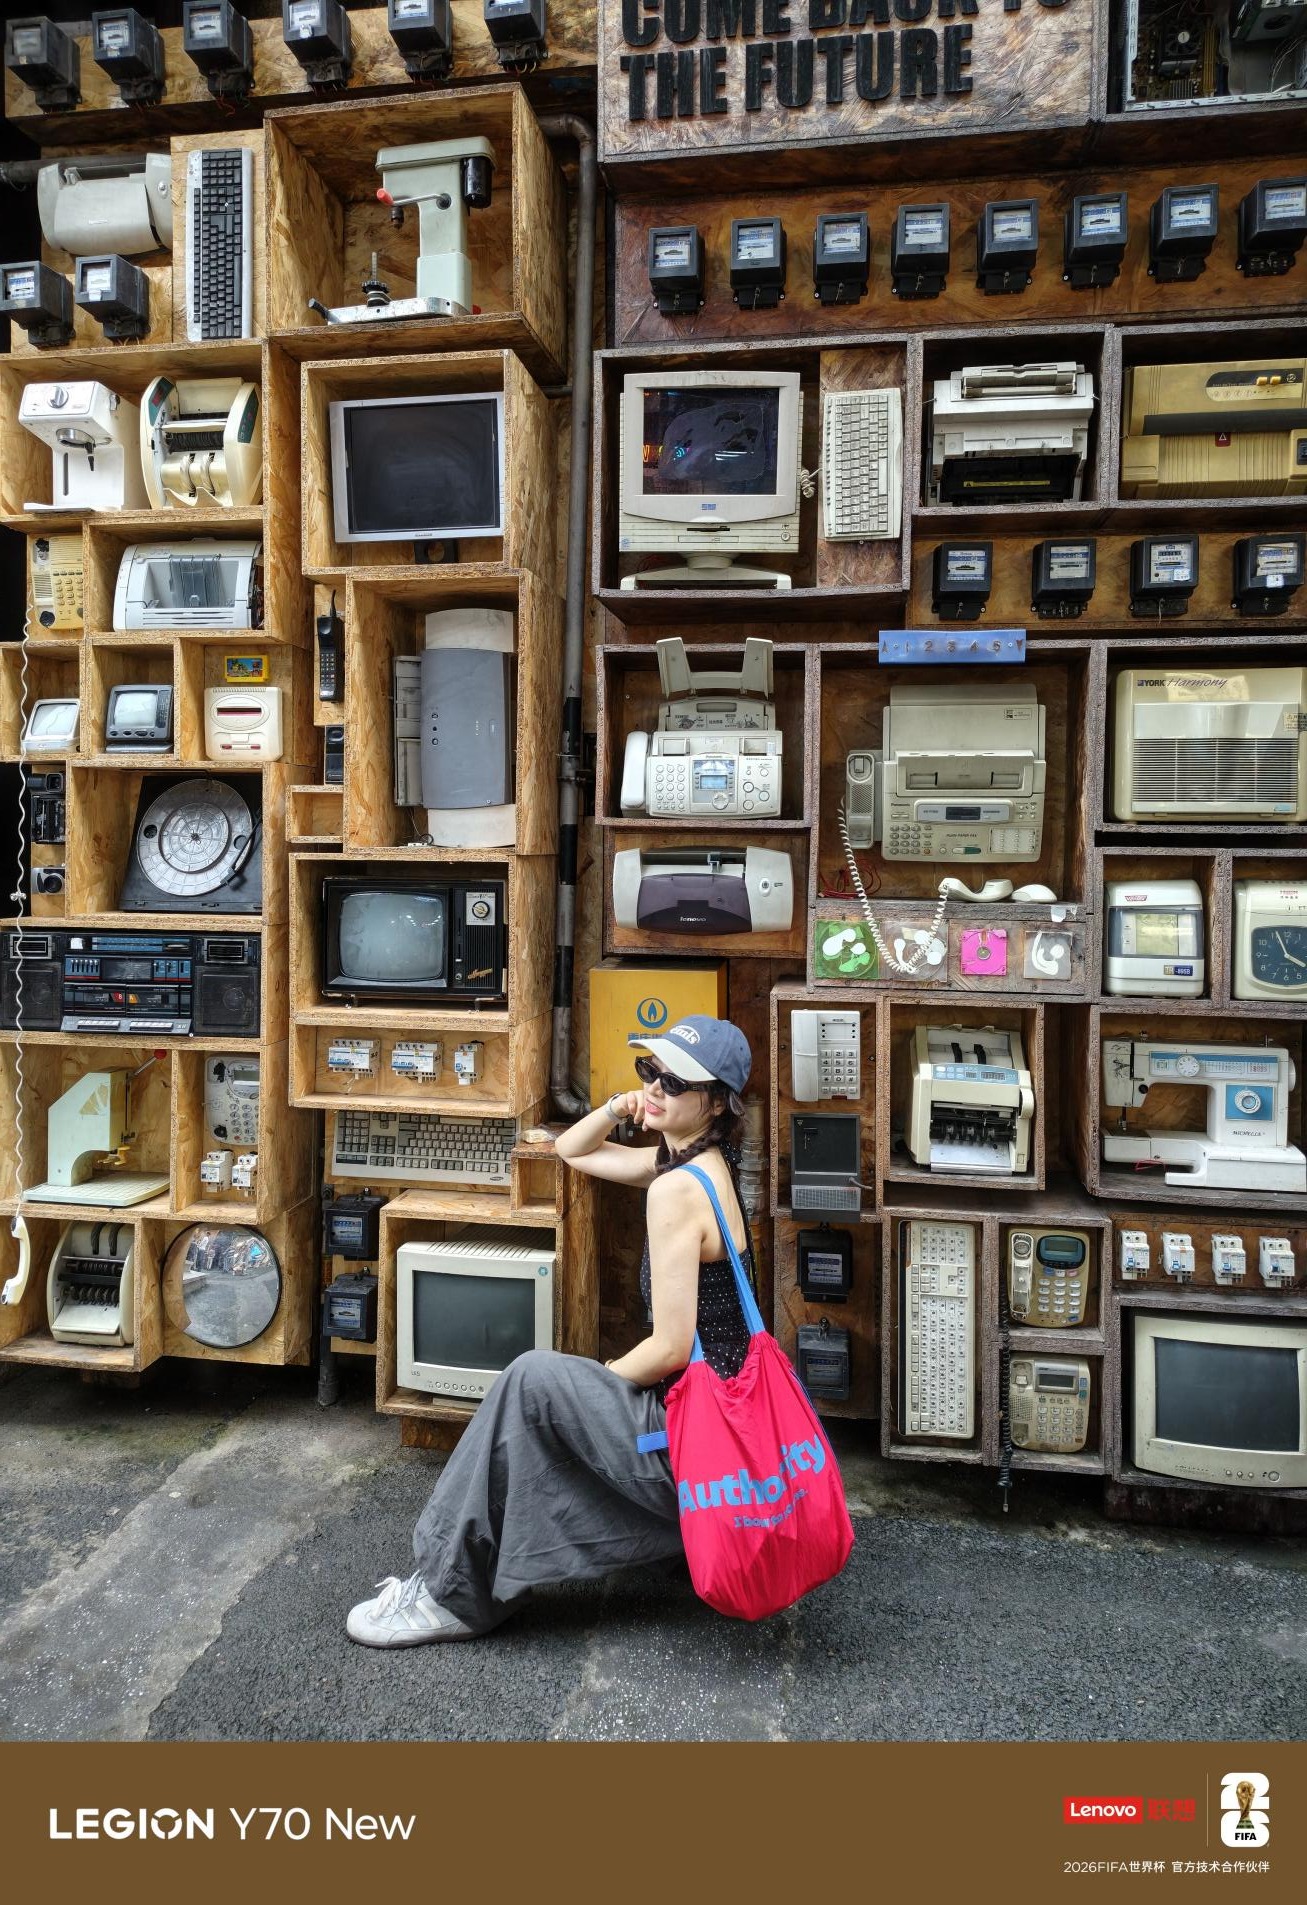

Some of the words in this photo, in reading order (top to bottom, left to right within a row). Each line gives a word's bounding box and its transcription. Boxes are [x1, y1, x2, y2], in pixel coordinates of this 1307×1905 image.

[620, 47, 728, 120] THE
[744, 24, 973, 109] FUTURE
[924, 640, 933, 651] 2
[1144, 679, 1166, 687] YORK
[1167, 678, 1228, 689] Harmony
[1296, 972, 1302, 980] 5
